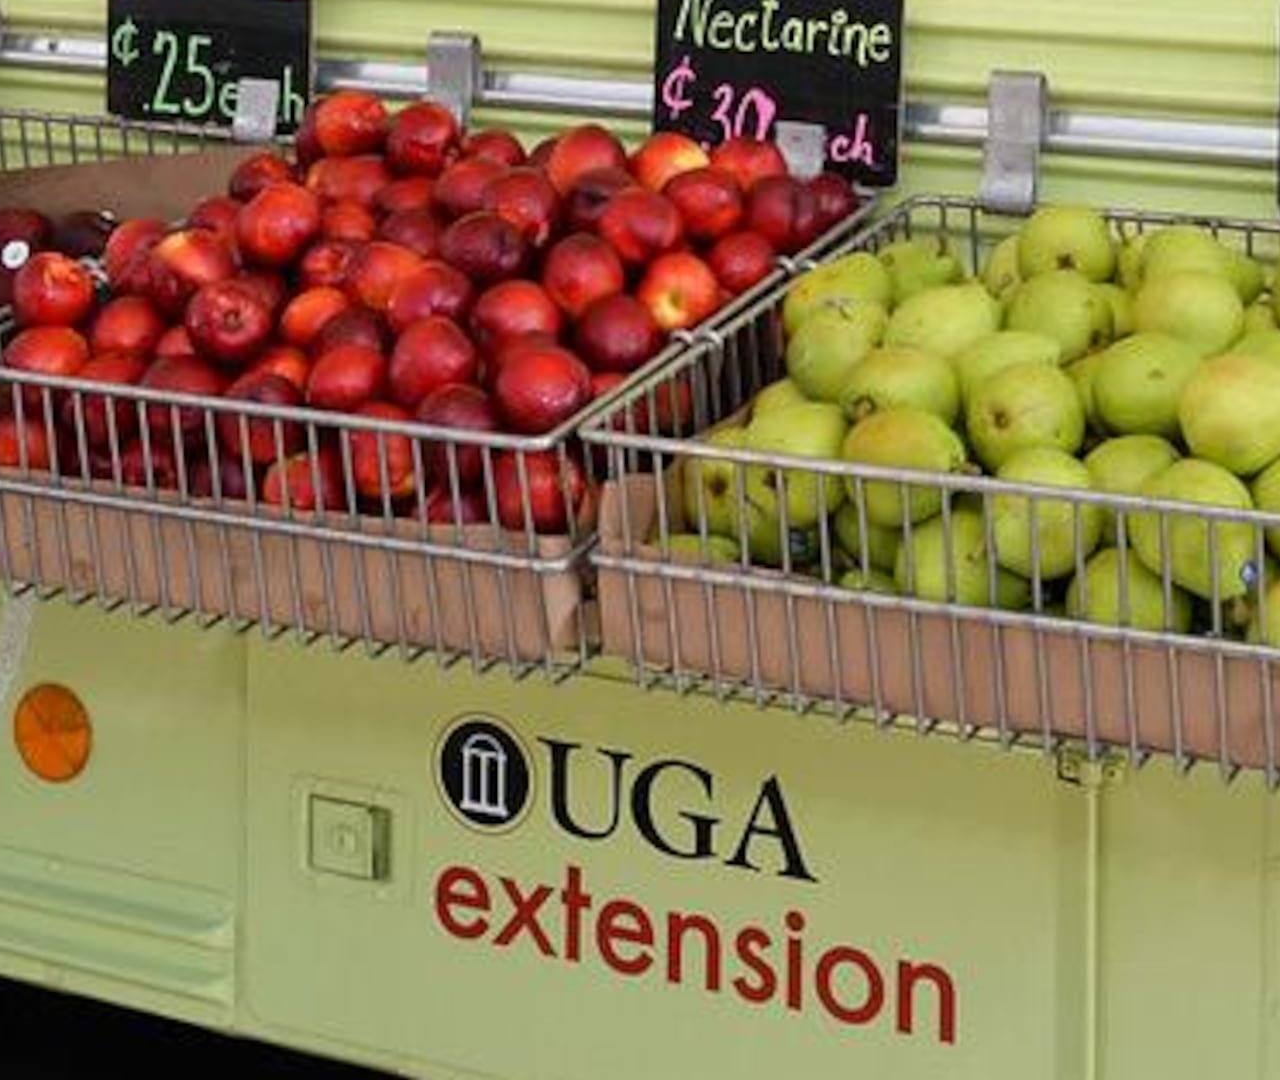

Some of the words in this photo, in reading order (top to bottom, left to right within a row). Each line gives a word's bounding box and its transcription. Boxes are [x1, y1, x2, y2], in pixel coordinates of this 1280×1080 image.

[220, 65, 304, 122] eh
[537, 736, 819, 884] UGA
[434, 865, 958, 1046] extension
